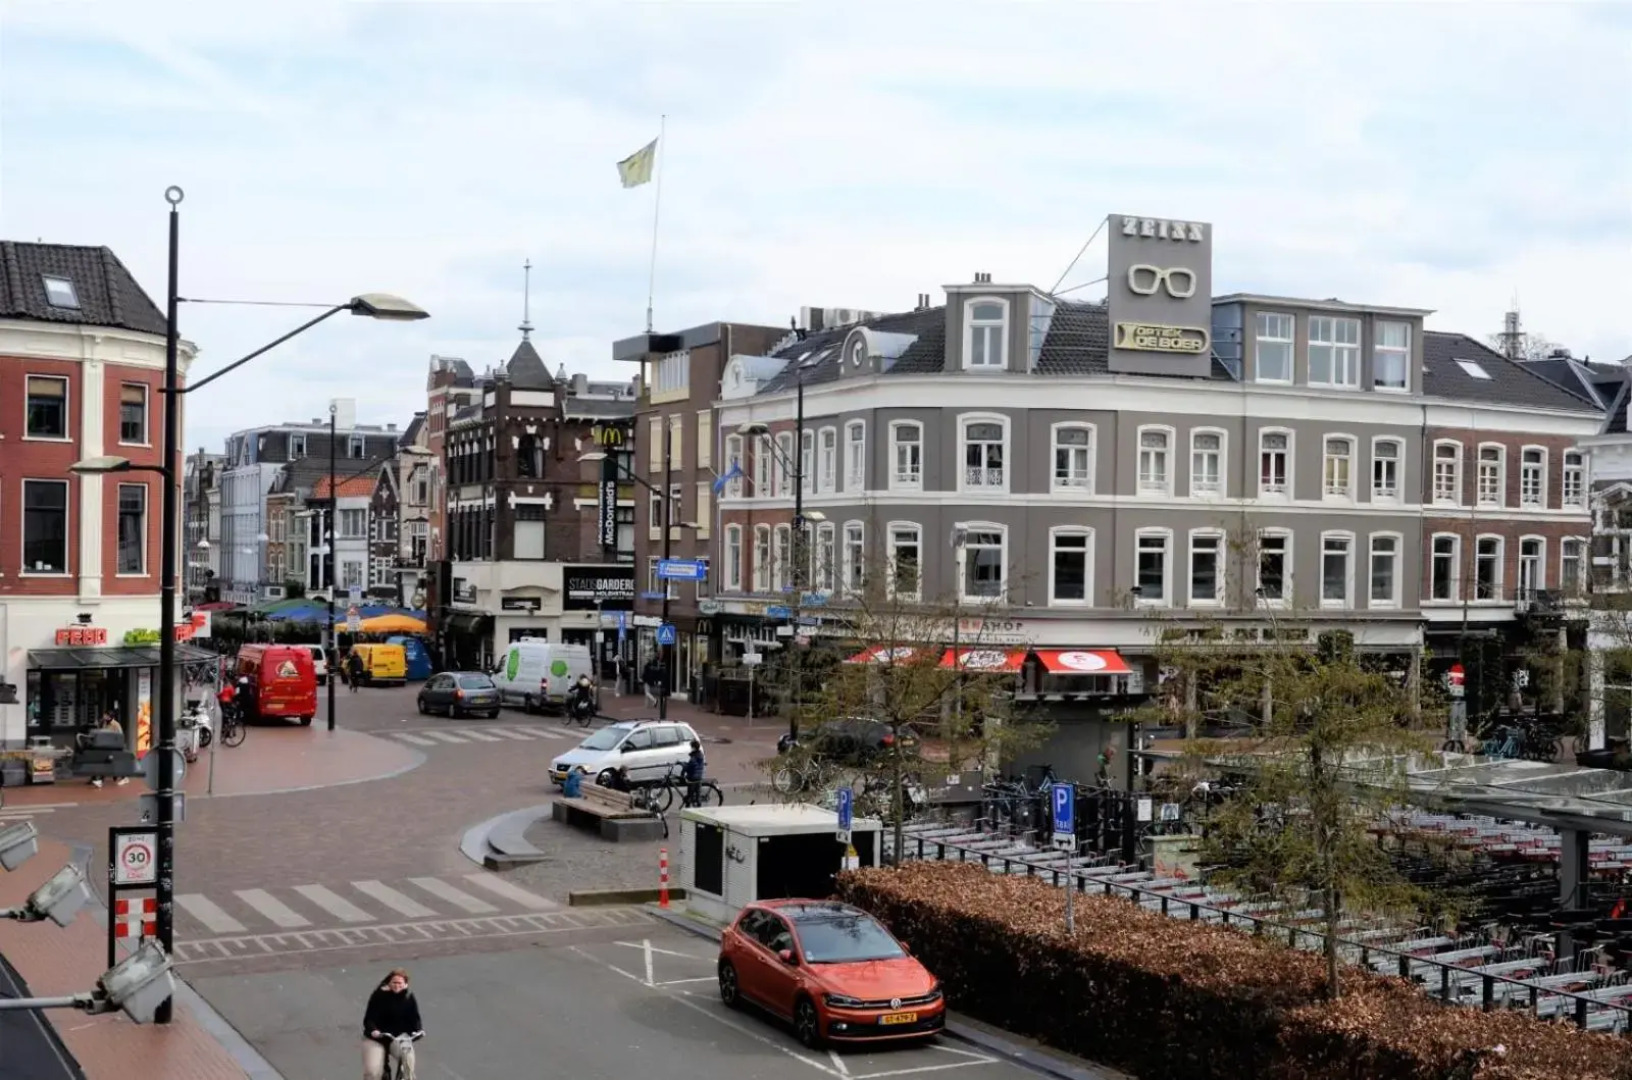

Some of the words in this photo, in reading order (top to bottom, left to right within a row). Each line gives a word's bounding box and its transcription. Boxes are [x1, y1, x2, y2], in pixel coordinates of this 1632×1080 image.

[1122, 216, 1204, 242] ZEISS
[1136, 326, 1183, 338] OPTIEK
[1159, 338, 1203, 351] BOER
[605, 481, 615, 545] McDonald's
[128, 852, 146, 864] 30
